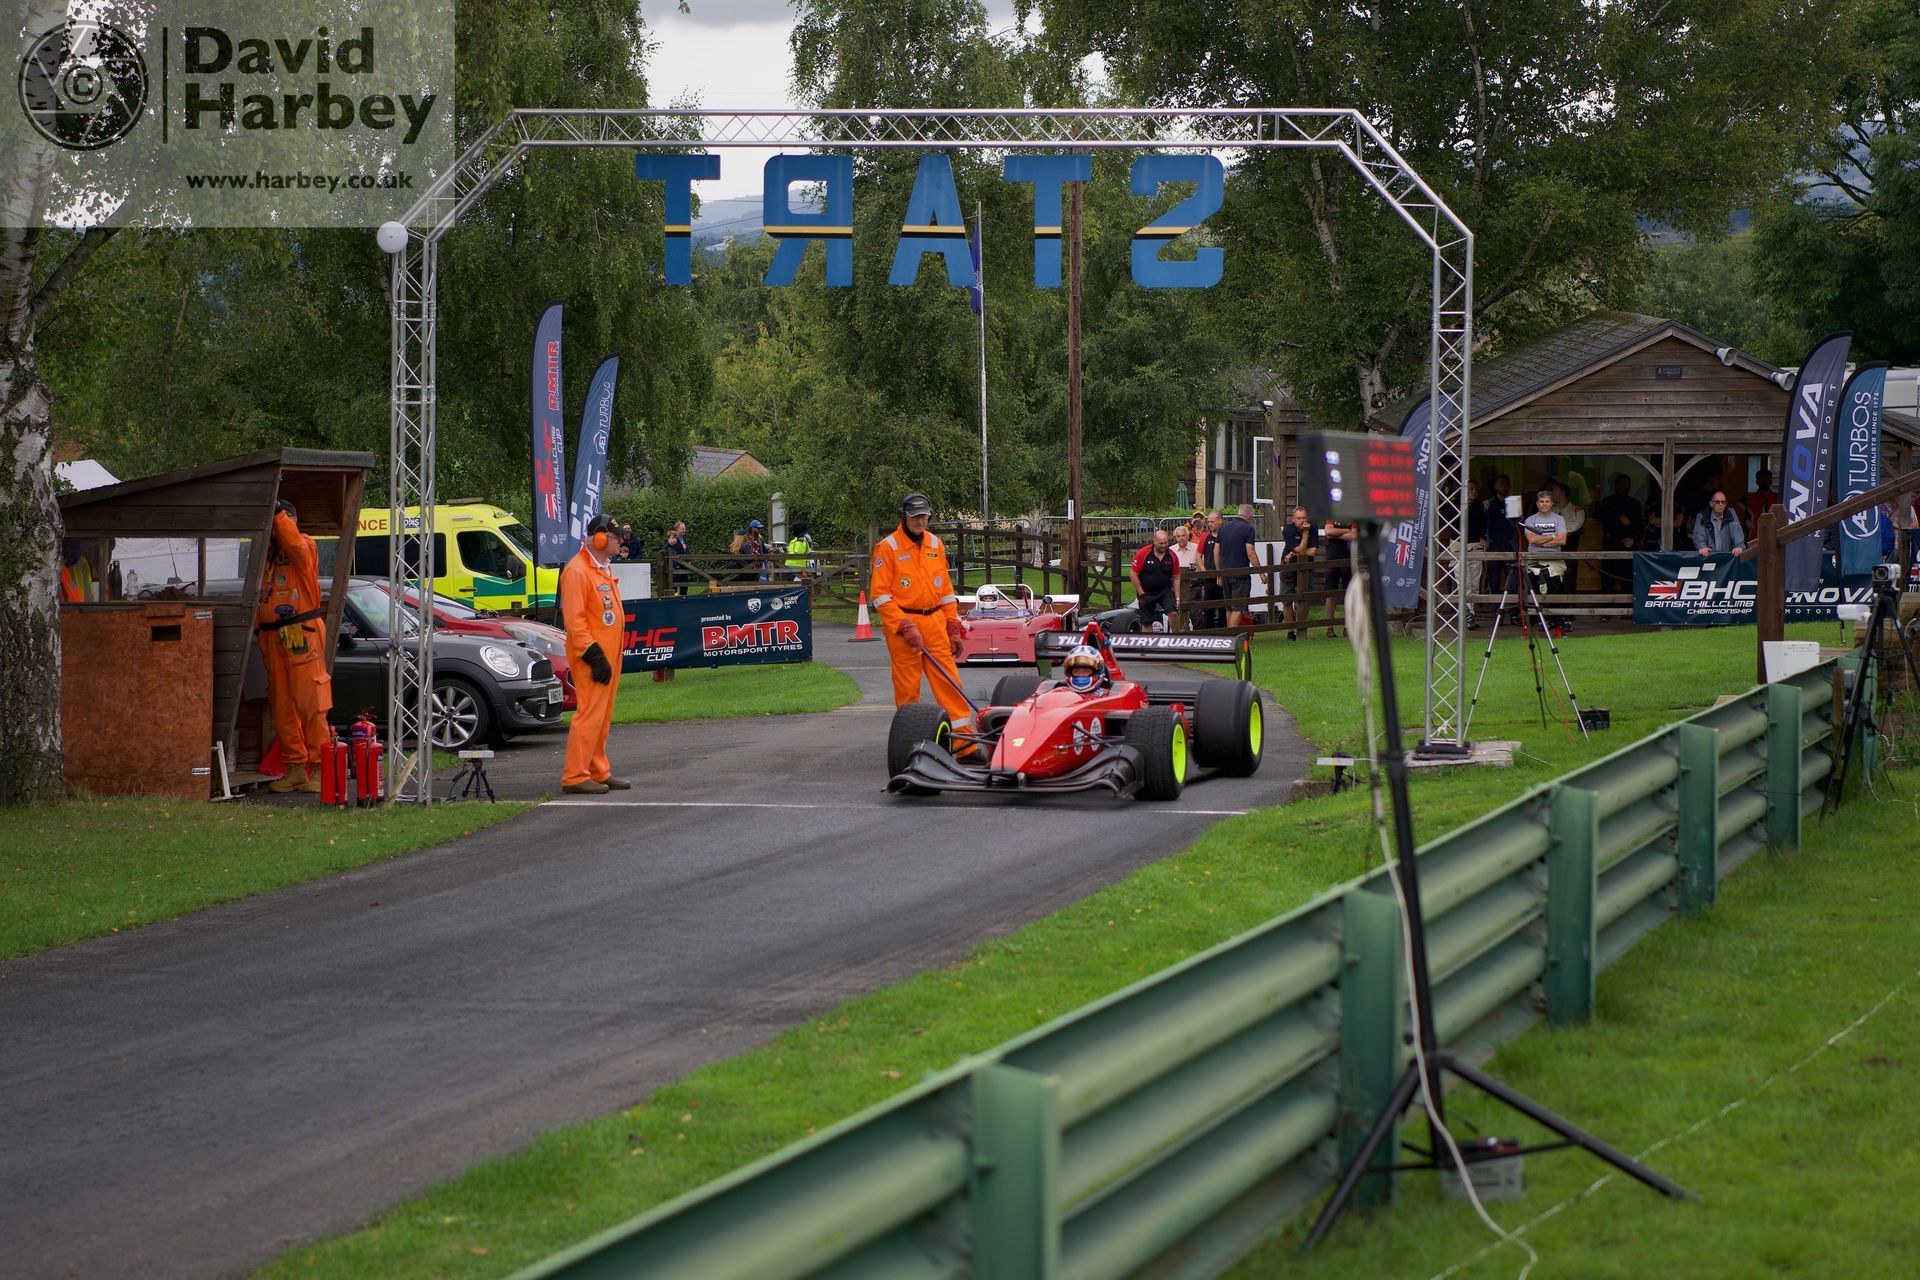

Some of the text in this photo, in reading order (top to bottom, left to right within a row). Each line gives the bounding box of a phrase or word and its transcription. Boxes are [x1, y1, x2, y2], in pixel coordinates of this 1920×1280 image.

[1848, 391, 1872, 486] TURBOS
[1814, 384, 1837, 538] MTORSPORT
[1680, 580, 1758, 600] BHC
[1644, 600, 1754, 608] BRITISH HILLCLIMB
[725, 614, 732, 622] by
[702, 620, 802, 651] BMTR
[646, 653, 673, 662] CUP
[703, 643, 803, 657] MOTORSPORT TYRES
